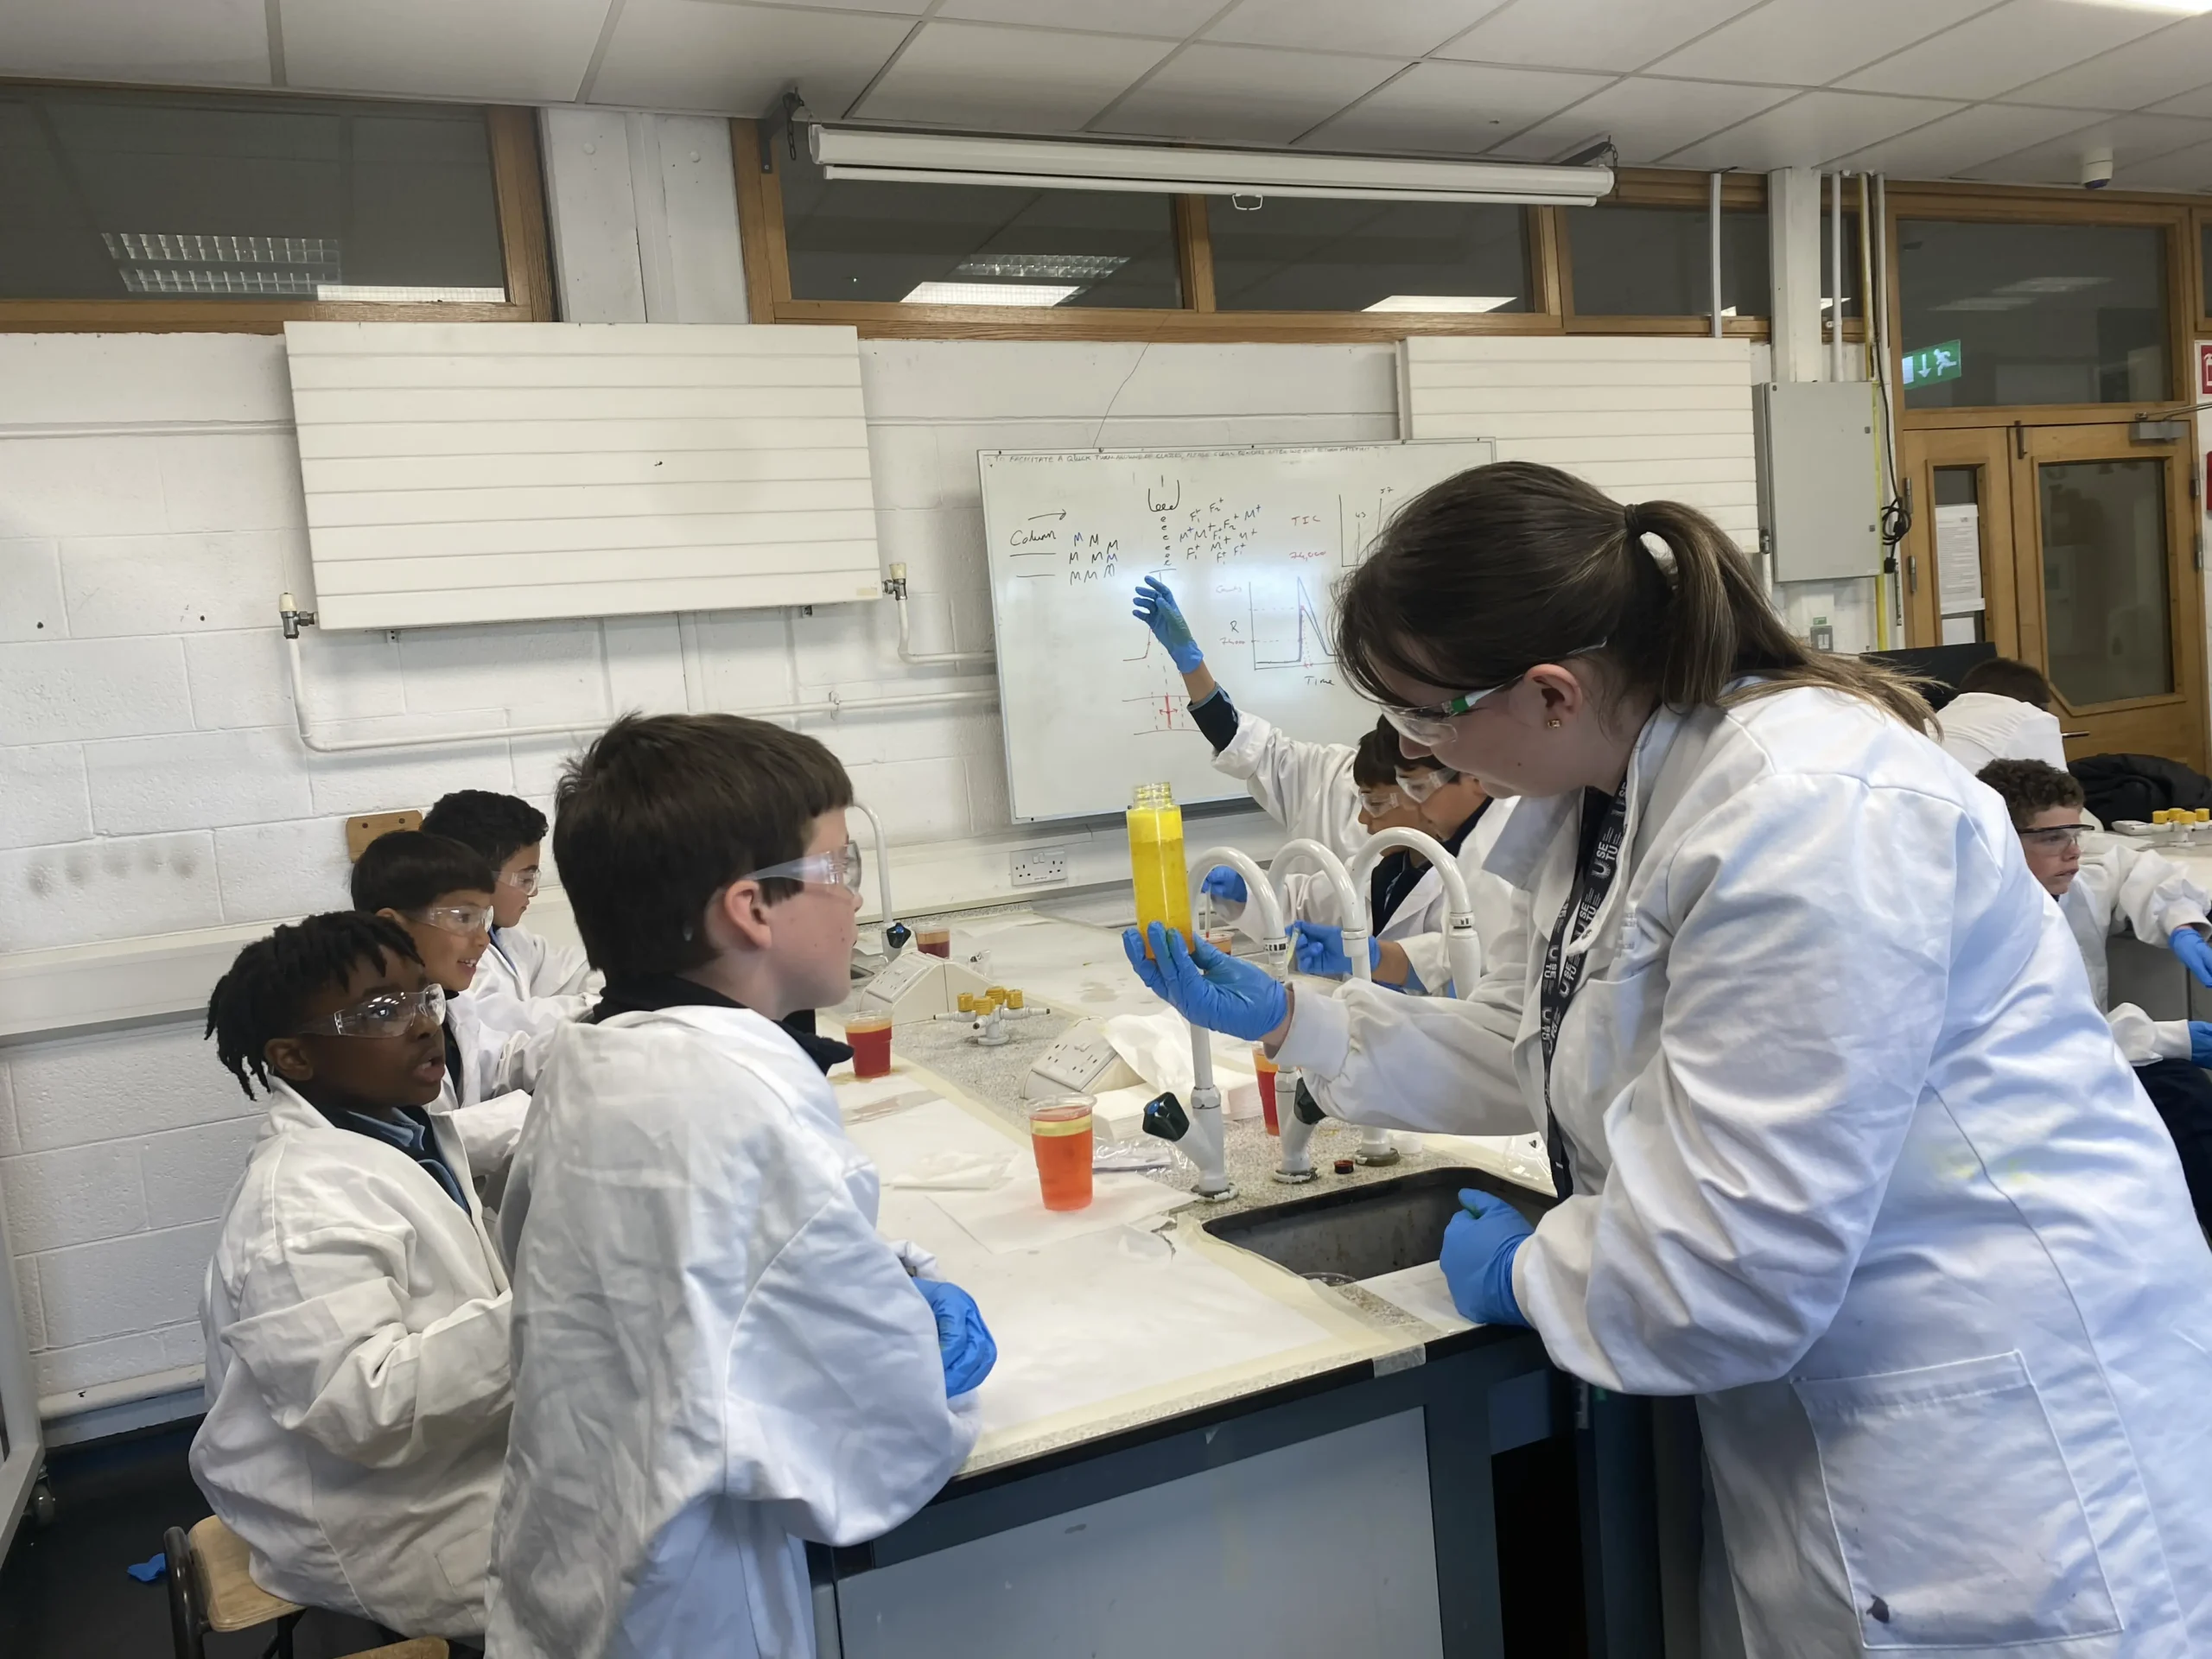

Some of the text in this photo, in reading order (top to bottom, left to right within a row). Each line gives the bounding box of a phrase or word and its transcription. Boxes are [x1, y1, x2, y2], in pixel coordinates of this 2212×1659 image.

[1010, 530, 1057, 546] Column
[1230, 620, 1240, 633] R
[1304, 676, 1336, 687] Time
[1596, 842, 1609, 859] SE
[1605, 844, 1618, 861] TU
[1580, 902, 1590, 918] SE
[1586, 906, 1597, 921] TU
[1544, 963, 1552, 979] TU
[1563, 963, 1573, 978] SE
[1568, 965, 1577, 981] TU
